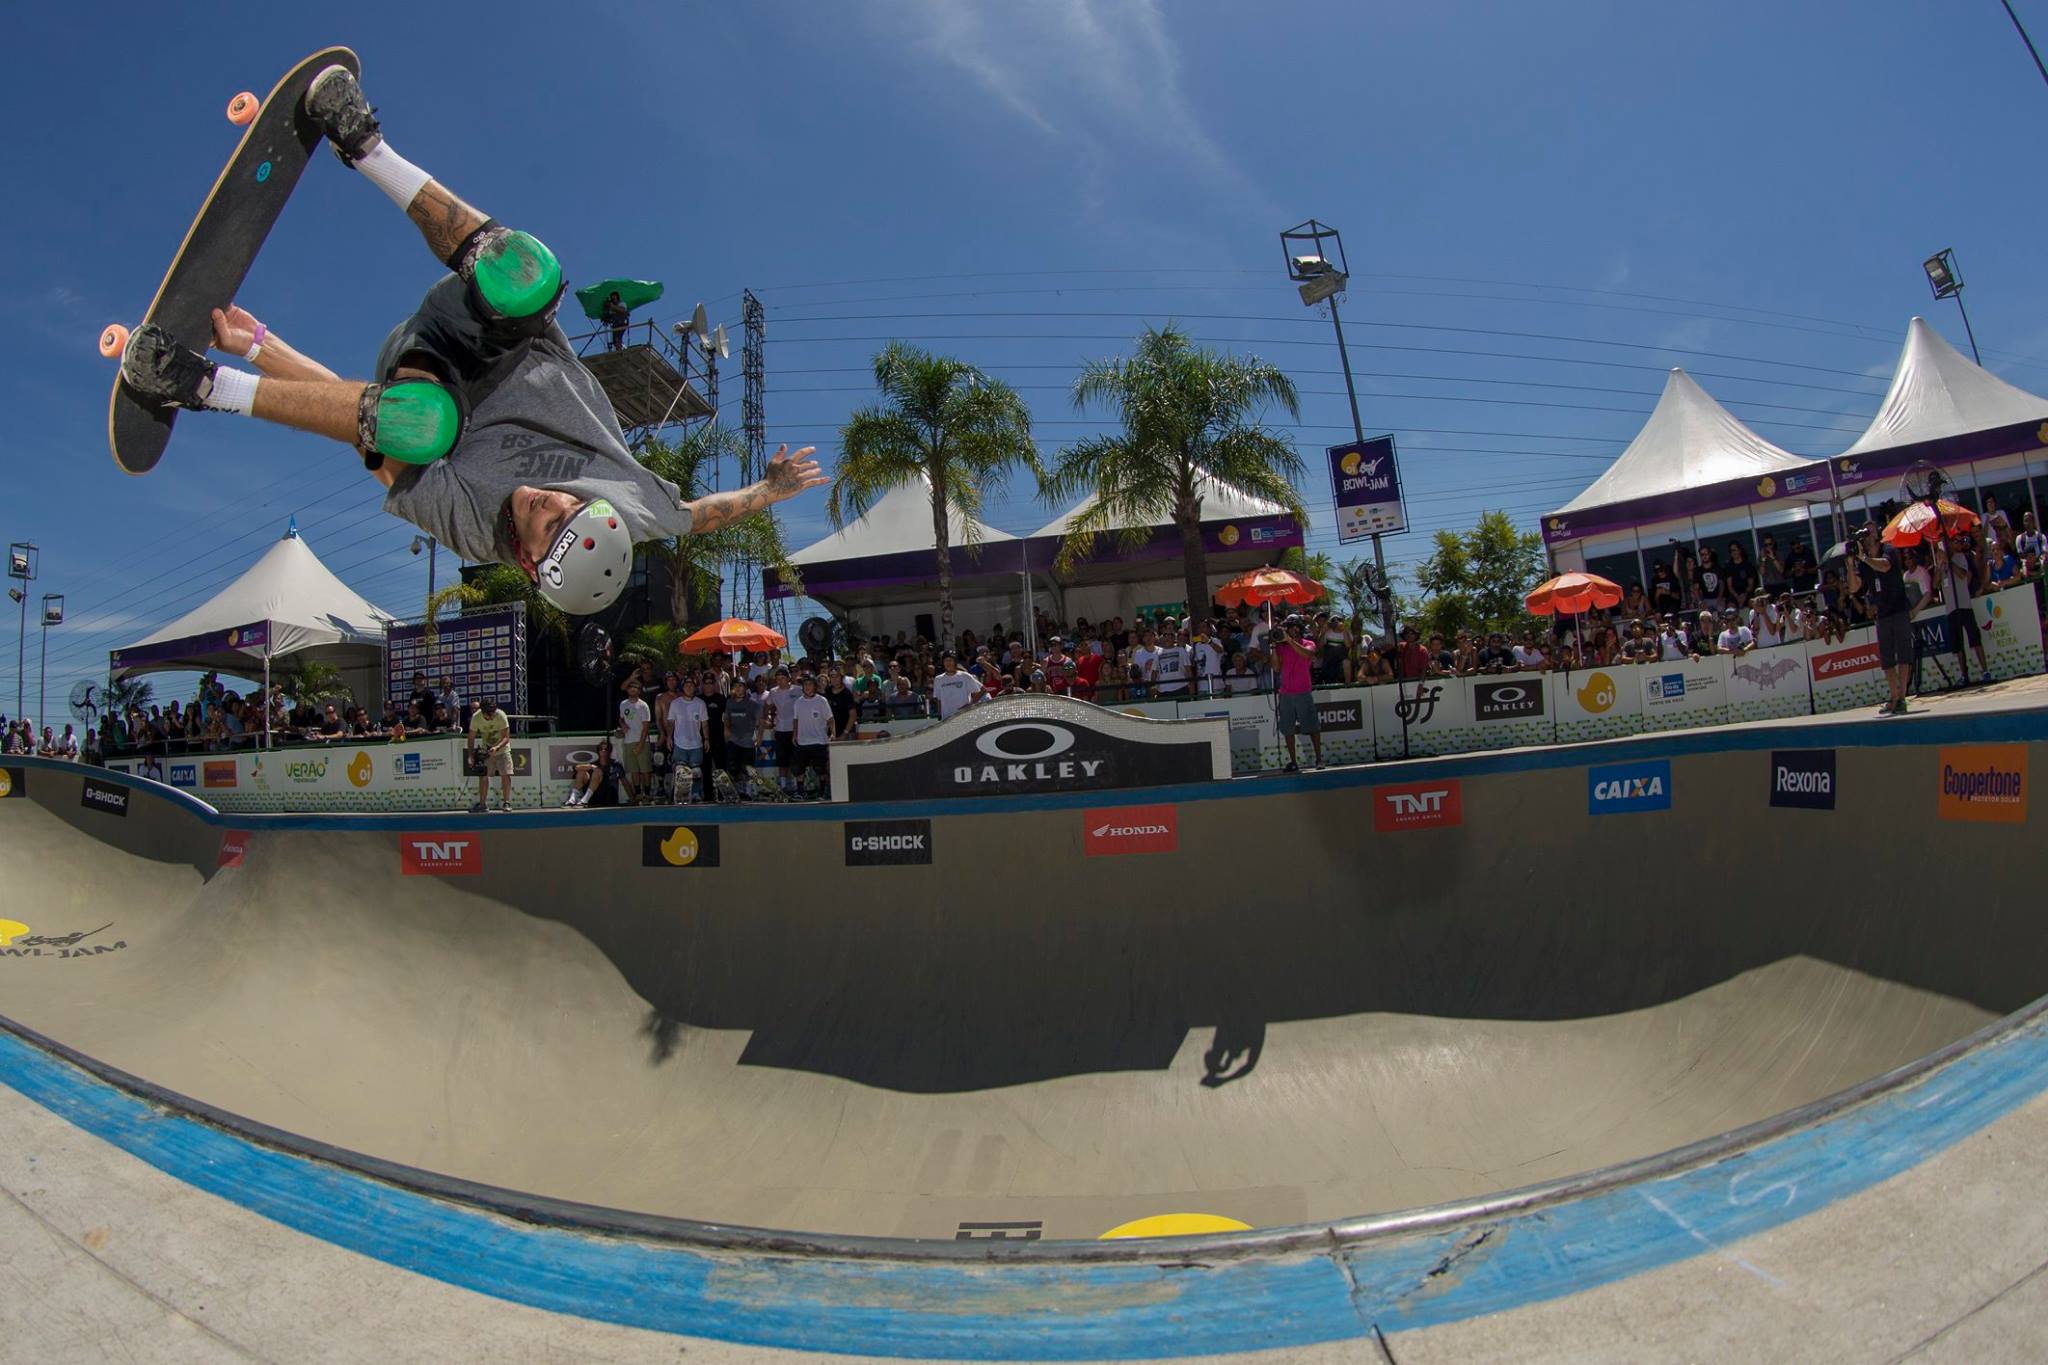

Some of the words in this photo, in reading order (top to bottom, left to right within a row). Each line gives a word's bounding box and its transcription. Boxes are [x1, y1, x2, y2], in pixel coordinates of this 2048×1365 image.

[501, 434, 535, 449] SB
[514, 451, 587, 479] NIKE
[1831, 653, 1880, 670] HONDA
[1596, 685, 1614, 705] oi
[1484, 701, 1535, 713] OAKLEY
[172, 769, 195, 782] CAIXA
[285, 760, 326, 778] VERÃO
[359, 765, 370, 781] oi
[954, 760, 1101, 783] OAKLEY
[1776, 766, 1831, 793] Rexona
[1944, 764, 2020, 801] Coppertone
[86, 788, 125, 806] G-SHOCK
[1594, 776, 1663, 801] CAIXA
[1386, 790, 1449, 814] TNT
[1109, 825, 1169, 836] HONDA
[412, 842, 469, 859] TNT
[679, 841, 695, 858] oi
[852, 835, 924, 851] G-SHOCK
